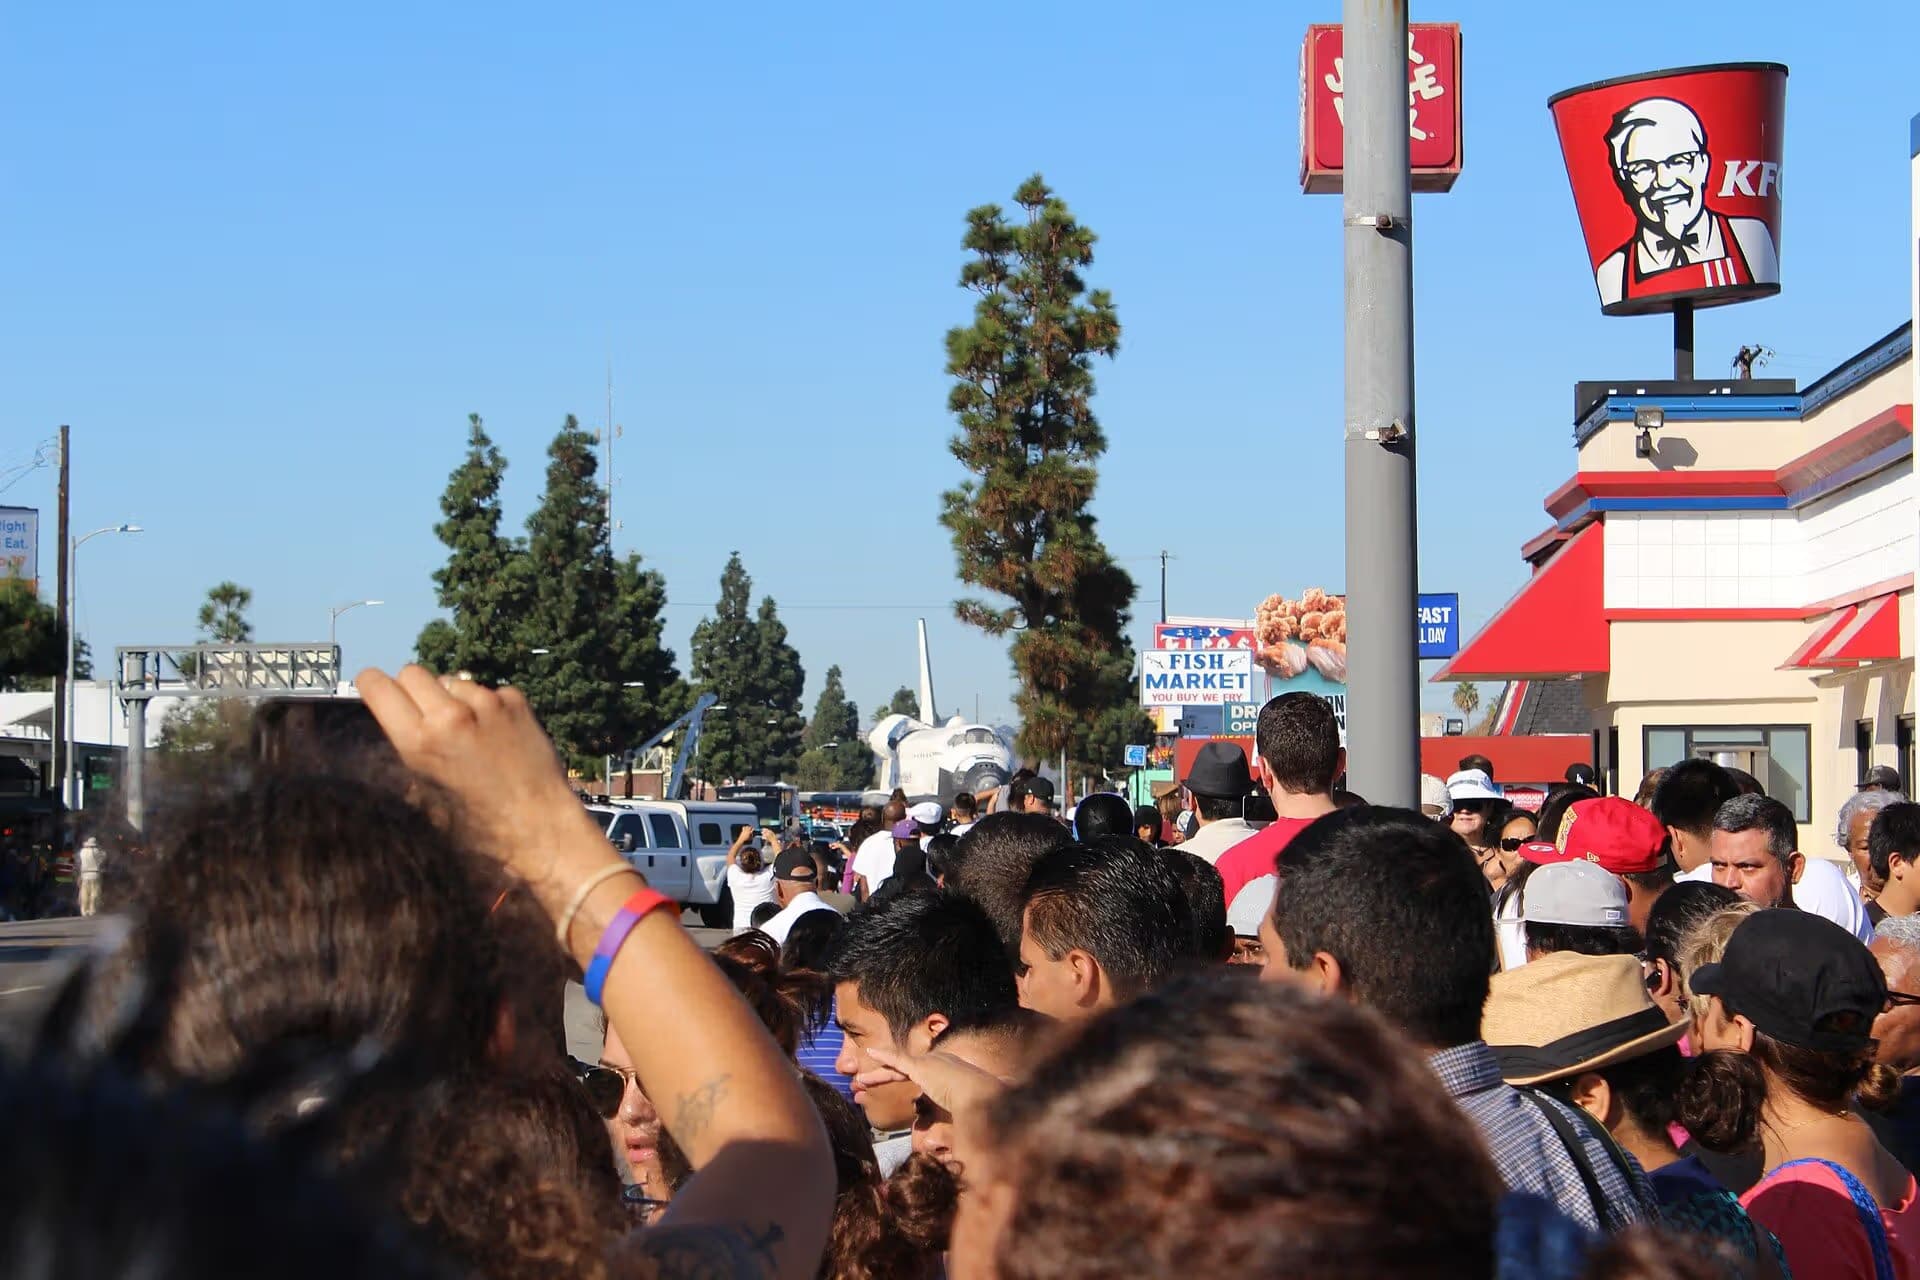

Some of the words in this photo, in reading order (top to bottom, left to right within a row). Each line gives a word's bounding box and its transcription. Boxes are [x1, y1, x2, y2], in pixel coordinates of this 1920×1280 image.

[1428, 627, 1446, 644] DAY
[1169, 653, 1224, 670] FISH
[1145, 673, 1248, 689] MARKET
[1152, 693, 1173, 702] YOU
[1176, 693, 1198, 702] BUY
[1202, 693, 1219, 702] WE
[1223, 693, 1243, 702] FRY
